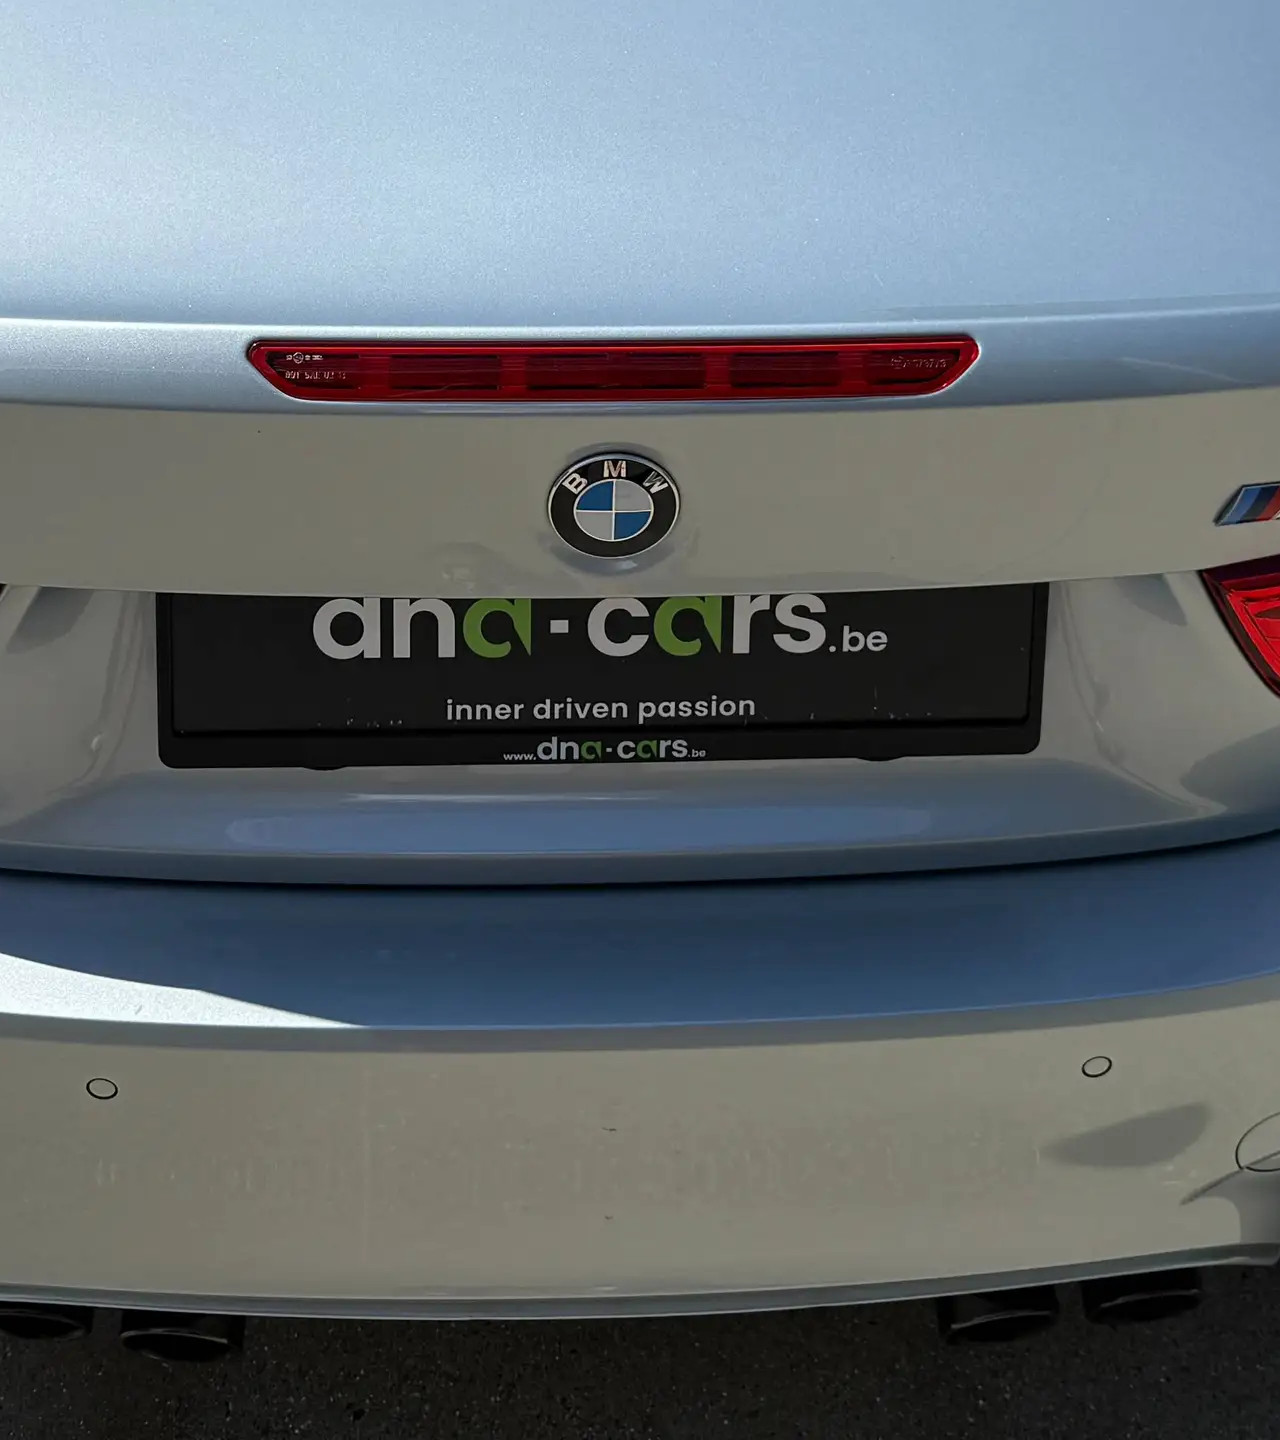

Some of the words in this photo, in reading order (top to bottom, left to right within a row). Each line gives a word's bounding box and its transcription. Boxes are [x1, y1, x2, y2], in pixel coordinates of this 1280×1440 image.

[561, 460, 669, 495] BMW
[446, 698, 524, 721] inner
[532, 697, 628, 720] driven
[637, 695, 756, 725] passion
[502, 736, 707, 761] www.dna-cars.be
